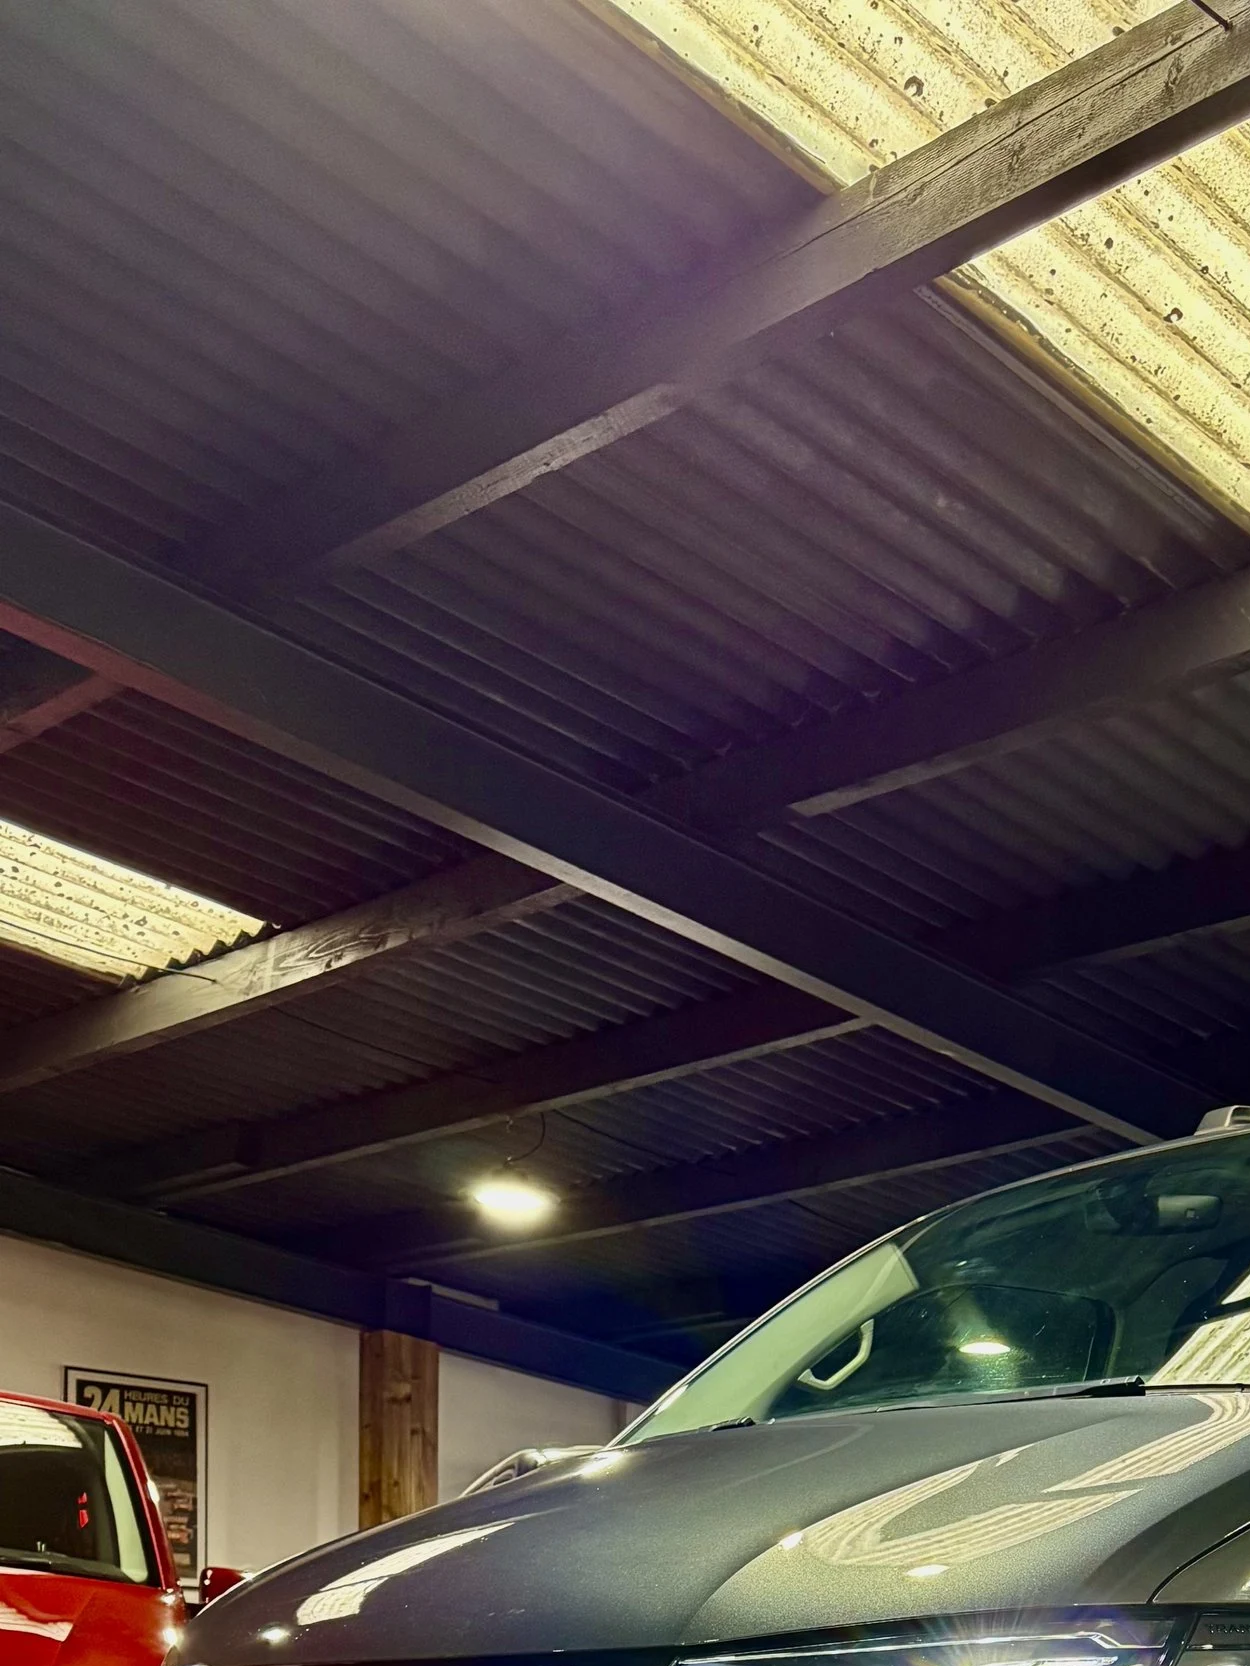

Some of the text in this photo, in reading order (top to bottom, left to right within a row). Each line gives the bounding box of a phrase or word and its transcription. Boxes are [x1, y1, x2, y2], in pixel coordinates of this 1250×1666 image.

[83, 1385, 120, 1416] 24
[124, 1389, 190, 1406] HEURES DU
[124, 1401, 190, 1428] MANS
